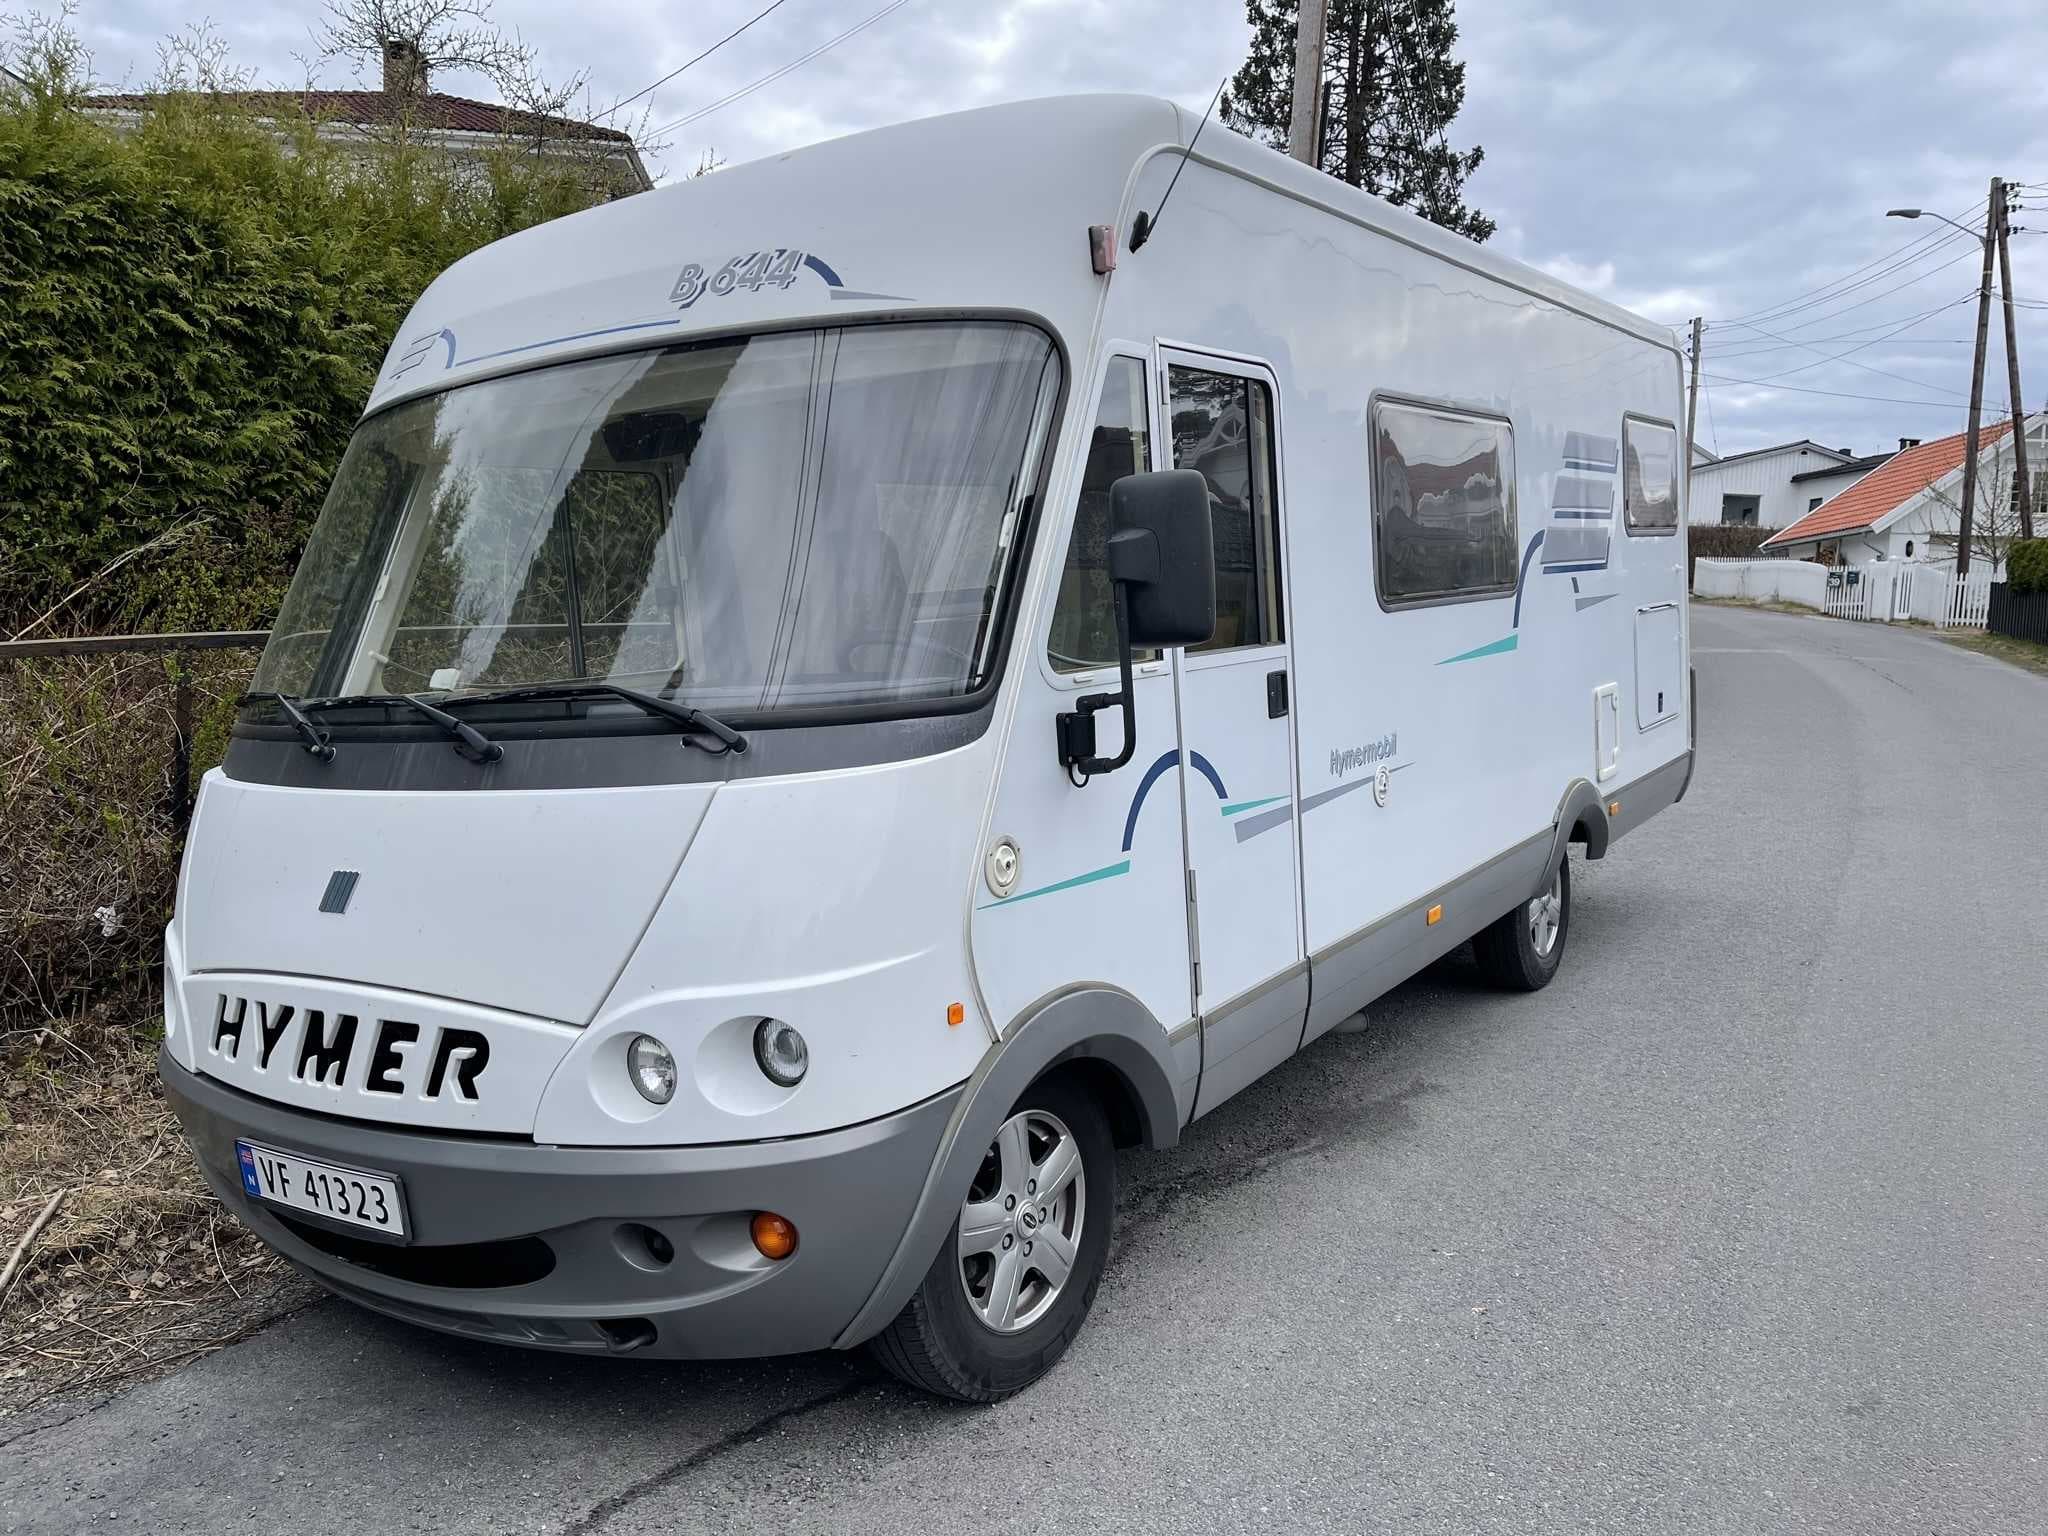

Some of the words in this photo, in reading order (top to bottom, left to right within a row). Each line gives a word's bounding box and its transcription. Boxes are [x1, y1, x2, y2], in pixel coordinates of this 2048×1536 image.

[668, 263, 705, 304] B
[710, 249, 802, 297] 644
[1330, 733, 1397, 778] Hymermobil
[208, 993, 490, 1104] HYMER
[247, 1173, 257, 1187] N
[258, 1156, 291, 1199] VF
[304, 1169, 390, 1225] 41323
